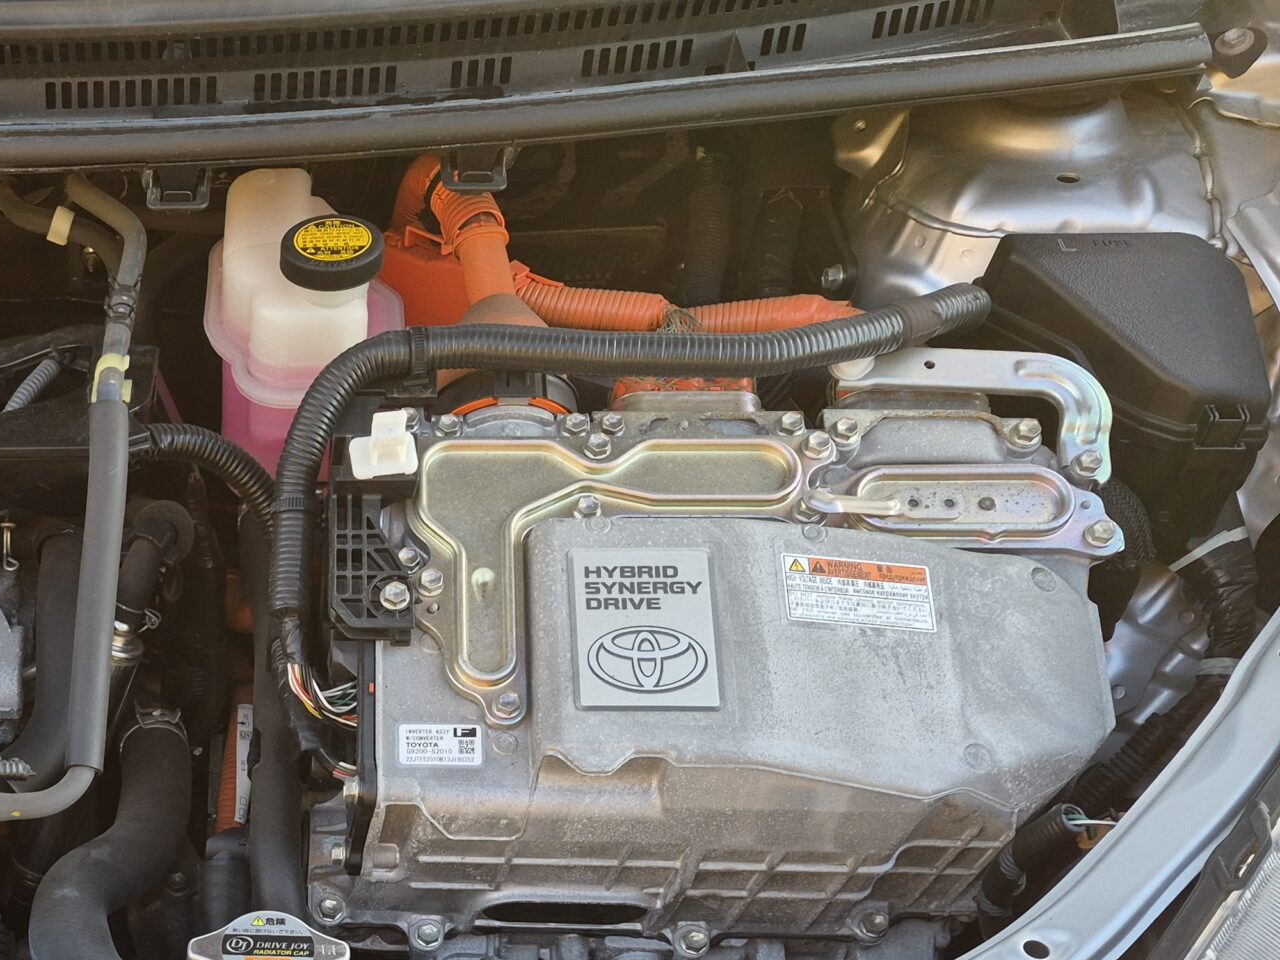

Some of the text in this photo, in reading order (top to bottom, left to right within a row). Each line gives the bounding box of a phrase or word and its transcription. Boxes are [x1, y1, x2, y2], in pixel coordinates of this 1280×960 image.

[584, 565, 679, 579] HYBRID
[826, 560, 863, 572] WARNING
[584, 581, 703, 595] SYNERGY
[585, 597, 662, 610] DRIVE
[265, 917, 286, 926] 危険
[256, 941, 288, 949] DRIVE
[320, 944, 337, 956] 1.1
